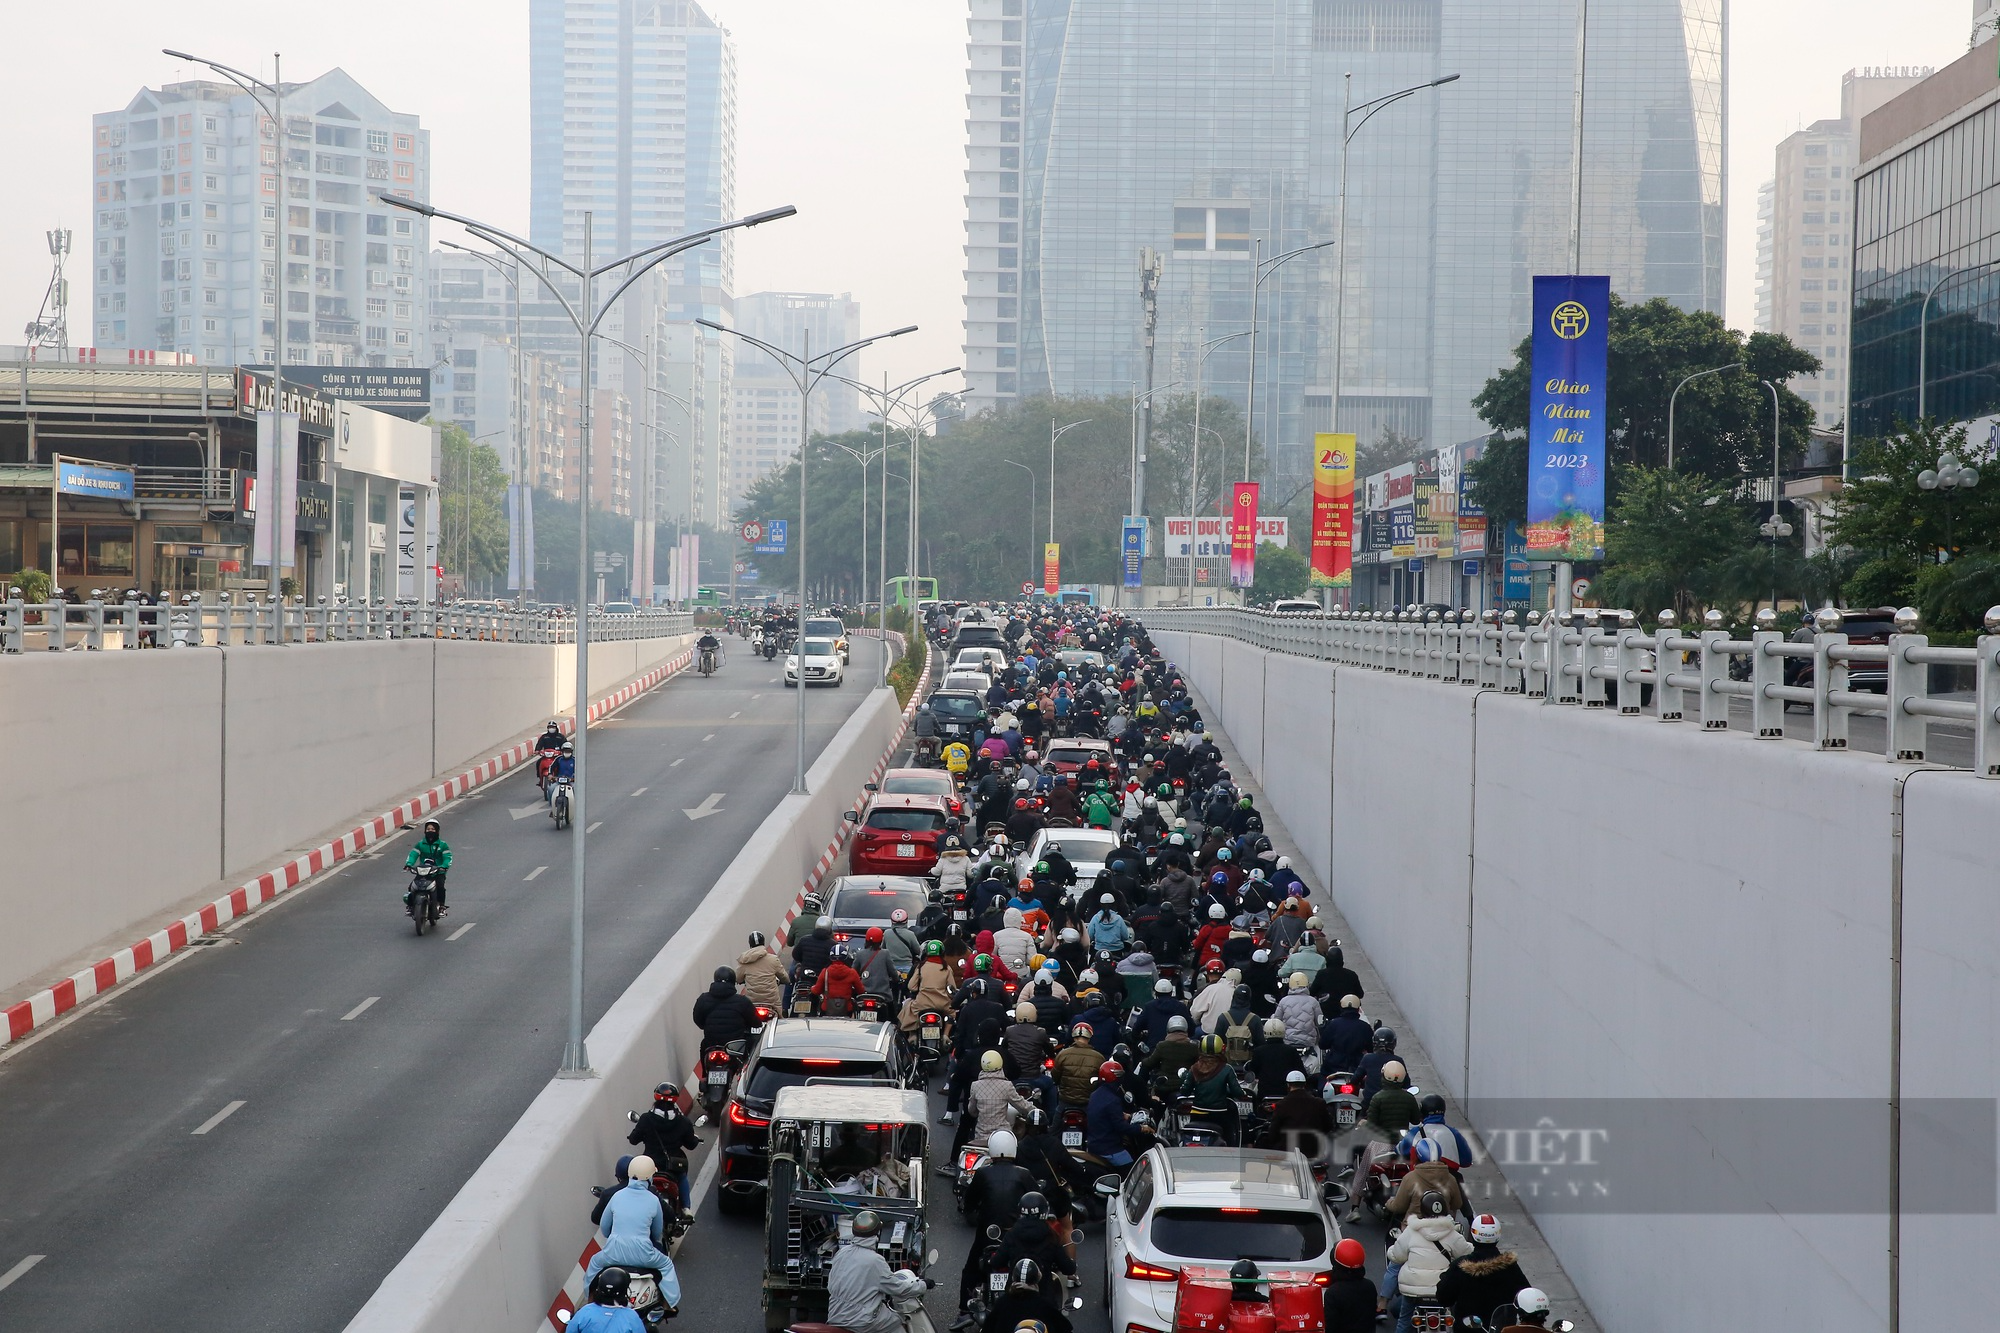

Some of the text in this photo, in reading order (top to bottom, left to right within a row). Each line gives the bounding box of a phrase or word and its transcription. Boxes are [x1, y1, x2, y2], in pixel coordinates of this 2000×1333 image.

[322, 373, 422, 385] CÔNG TY KINH DOANH
[344, 388, 353, 398] BỊ
[366, 387, 377, 397] XE
[378, 386, 399, 397] SÔNG
[400, 386, 422, 398] HỒNG
[1545, 378, 1591, 395] Chào
[1543, 402, 1591, 419] Năm
[1547, 427, 1585, 444] Mới
[1544, 454, 1588, 469] 2023
[85, 478, 93, 488] XE
[1430, 494, 1455, 513] 110
[1394, 514, 1412, 524] AUTO
[1168, 521, 1285, 535] VIET DUC CPLEX
[1392, 525, 1415, 538] 116
[1198, 541, 1209, 555] LÊ
[1416, 536, 1439, 548] 118
